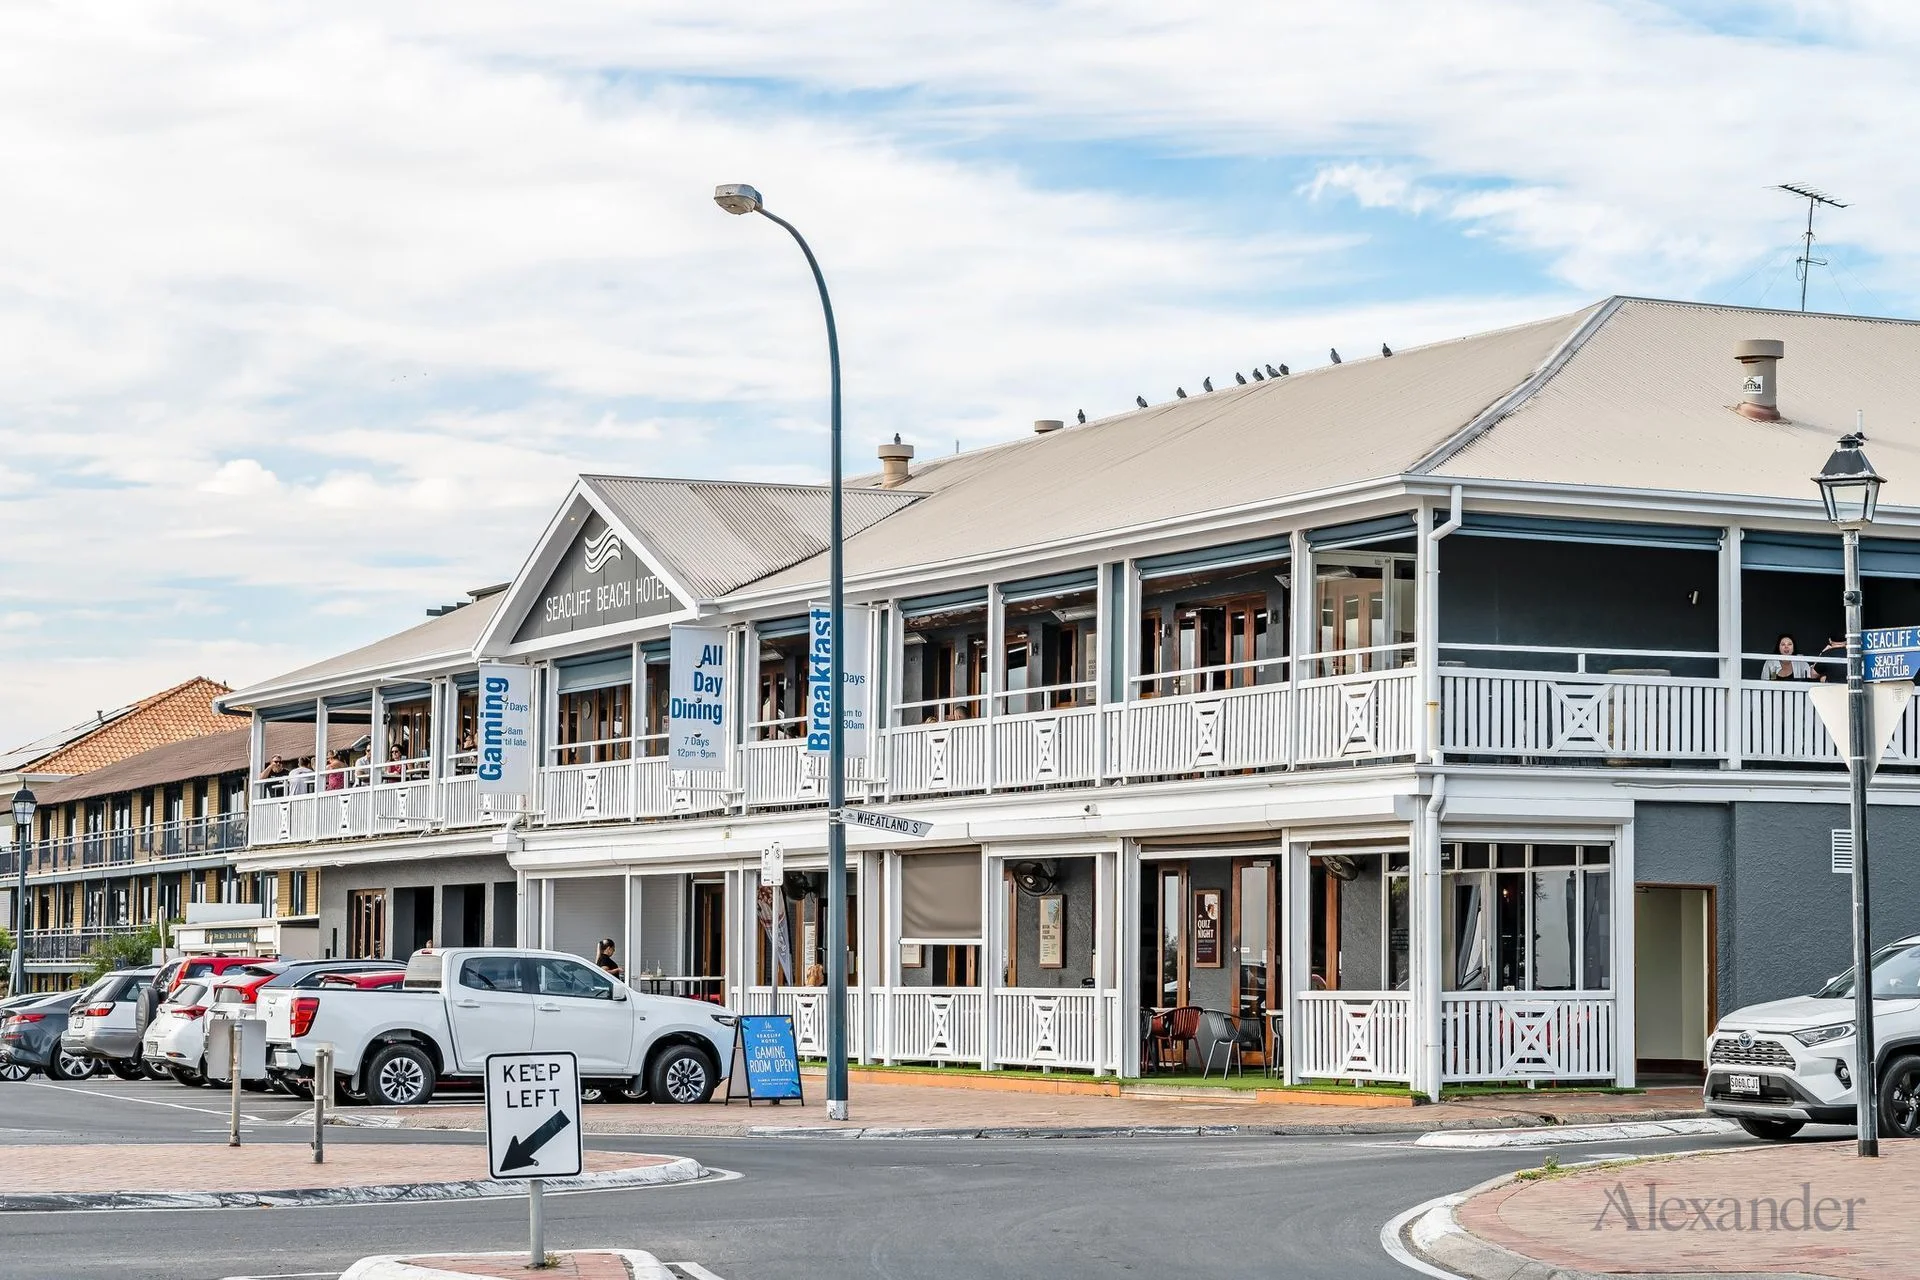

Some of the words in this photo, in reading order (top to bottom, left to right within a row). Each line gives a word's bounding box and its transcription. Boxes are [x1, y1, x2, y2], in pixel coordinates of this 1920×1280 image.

[545, 589, 591, 622] SEACLIFF
[597, 581, 631, 612] BEACH
[636, 576, 670, 604] HOTEL
[1866, 630, 1912, 649] SEACLIFF
[701, 645, 723, 666] All
[1874, 654, 1905, 667] SEACLIFF
[1870, 666, 1890, 678] YACHT
[1892, 664, 1910, 676] CLUB
[693, 671, 723, 697] Day
[807, 608, 832, 751] Breakfast
[842, 672, 865, 685] Days
[509, 702, 528, 713] Days
[671, 697, 723, 725] Dining
[855, 709, 862, 717] to
[478, 677, 509, 781] Gaming
[513, 738, 527, 746] late
[684, 737, 689, 745] 7
[691, 737, 709, 747] Days
[857, 811, 909, 832] WHEATLAND
[764, 848, 770, 859] P
[1197, 919, 1211, 929] QUIZ
[1197, 929, 1214, 939] NIGHT
[754, 1045, 786, 1059] GAMING
[503, 1063, 561, 1083] KEEP
[749, 1059, 772, 1073] ROOM
[774, 1059, 794, 1073] OPEN
[506, 1089, 560, 1109] LEFT
